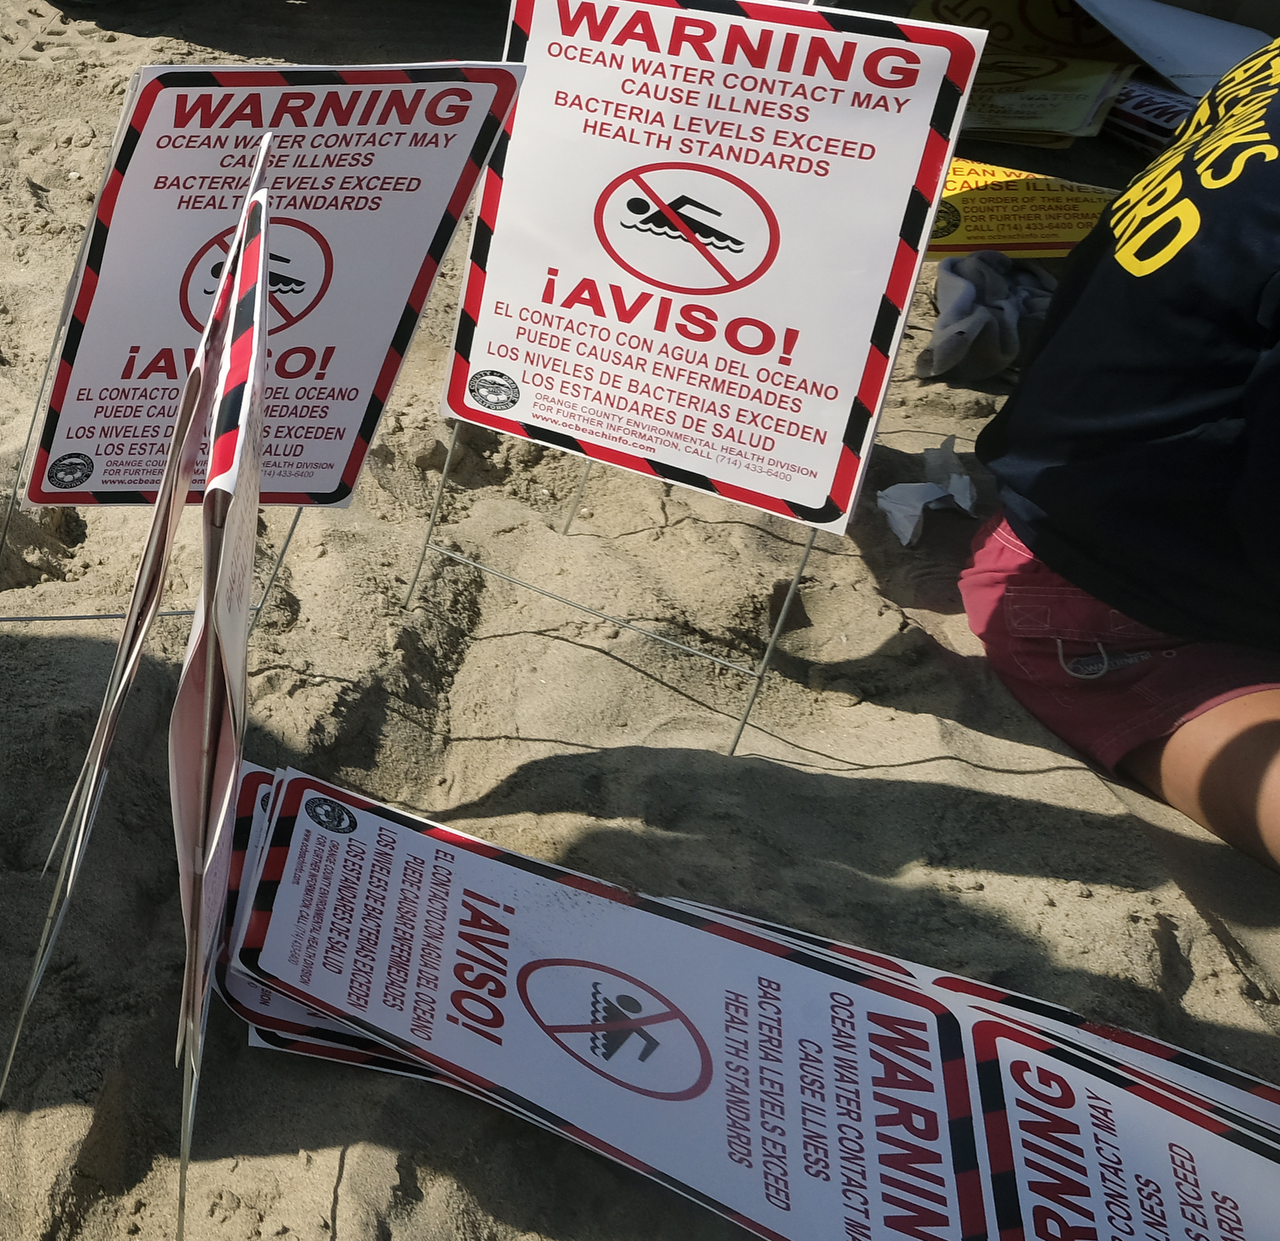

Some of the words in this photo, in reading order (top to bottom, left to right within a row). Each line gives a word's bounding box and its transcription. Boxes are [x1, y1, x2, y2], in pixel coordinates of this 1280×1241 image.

[173, 87, 472, 129] WARNING
[546, 42, 625, 70] OCEAN
[631, 56, 715, 87] WATER
[722, 72, 845, 104] CONTACT
[849, 90, 911, 114] MAY
[620, 77, 701, 107] CAUSE
[706, 92, 810, 123] ILLNESS
[155, 134, 229, 149] OCEAN
[309, 131, 407, 149] CONTACT
[407, 131, 458, 148] MAY
[291, 151, 375, 168] ILLNESS
[553, 89, 665, 128] BACTERIA
[672, 113, 766, 143] LEVELS
[771, 129, 876, 160] EXCEED
[582, 117, 672, 151] HEALTH
[678, 137, 830, 177] STANDARDS
[338, 175, 422, 192] EXCEED
[945, 180, 1019, 192] CAUSE
[962, 197, 976, 205] BY
[981, 196, 1018, 205] ORDER
[1022, 196, 1037, 205] OF
[1041, 196, 1063, 204] THE
[963, 206, 1009, 214] COUNTY
[1012, 205, 1027, 213] OF
[1032, 204, 1080, 213] ORANGE
[964, 215, 986, 223] FOR
[991, 213, 1042, 222] FURTHER
[965, 224, 991, 232] CALL
[493, 300, 513, 318] EL
[518, 306, 611, 342] CONTACTO
[615, 331, 654, 353] CON
[656, 342, 709, 369] AGUA
[713, 355, 750, 379] DEL
[755, 367, 839, 401] OCEANO
[541, 266, 799, 366] ¡AVISO!
[486, 340, 520, 361] LOS
[523, 349, 594, 381] NIVELES
[598, 370, 623, 390] DE
[626, 377, 731, 419] BACTERIAS
[734, 407, 828, 445] EXCEDEN
[515, 325, 572, 353] PUEDE
[575, 341, 647, 373] CAUSAR
[651, 360, 802, 413] ENFERMEDADES
[520, 369, 555, 391] LOS
[559, 379, 677, 425] ESTANDARES
[681, 413, 708, 434] DE
[710, 422, 775, 452] SALUD
[531, 412, 656, 453] www.ocbeachinfo.com
[532, 400, 554, 414] FOR
[555, 407, 604, 428] FURTHER
[605, 422, 681, 451] INFORMATION,
[683, 444, 712, 460] CALL
[715, 453, 742, 469] (714)
[743, 462, 792, 482] 433-6400
[534, 391, 578, 411] ORANGE
[580, 405, 624, 423] COUNTY
[625, 417, 717, 451] ENVIRONMENTAL
[719, 444, 765, 464] HEALTH
[766, 457, 818, 479] DIVISION
[445, 887, 515, 1045] ¡AVISO!
[723, 988, 749, 1061] HEALTH
[756, 975, 783, 1063] BACTERIA
[828, 991, 857, 1056] OCEAN
[758, 1064, 786, 1137] LEVELS
[796, 1037, 825, 1102] CAUSE
[832, 1054, 862, 1123] WATER
[723, 1059, 753, 1169] STANDARDS
[799, 1099, 831, 1182] ILLNESS
[866, 1011, 952, 1241] WARNIN
[1084, 1087, 1118, 1137] MAY
[760, 1134, 791, 1211] EXCEED
[836, 1122, 870, 1220] CONTACT
[1093, 1131, 1135, 1236] CONTACT
[1168, 1142, 1209, 1231] EXCEED
